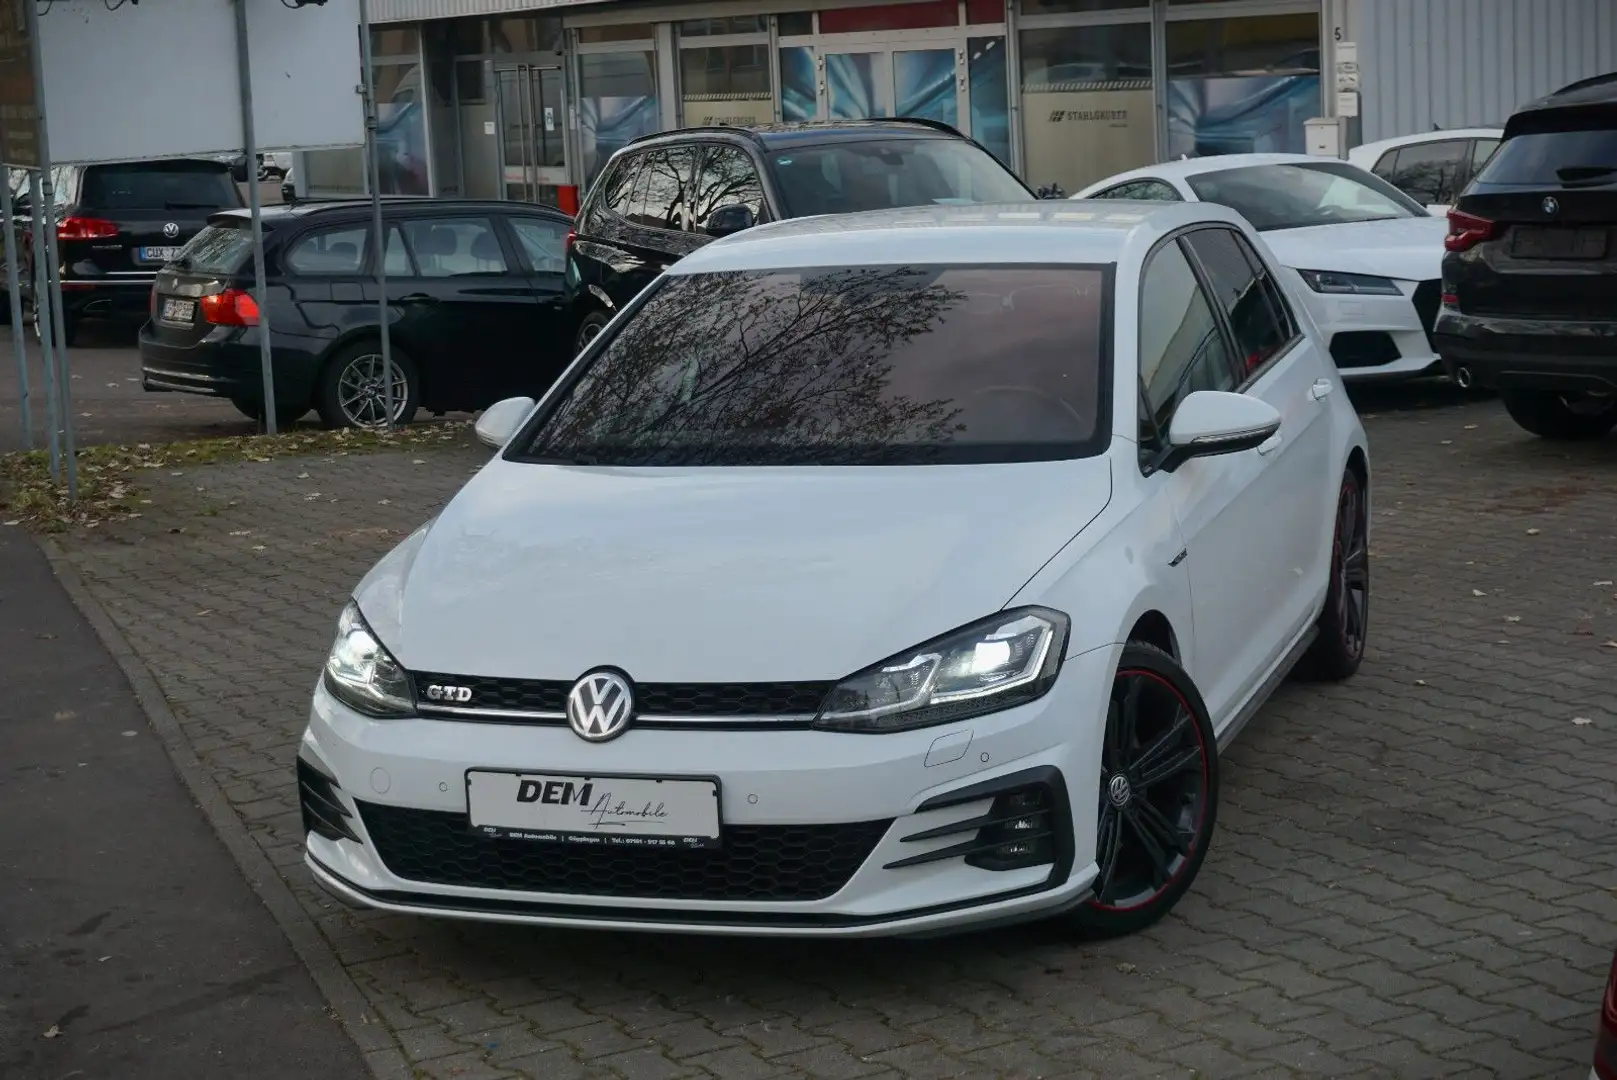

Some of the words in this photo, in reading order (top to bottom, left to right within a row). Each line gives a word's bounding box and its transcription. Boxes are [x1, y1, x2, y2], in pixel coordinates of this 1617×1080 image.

[1335, 26, 1342, 41] 5
[146, 247, 165, 258] CUX
[427, 684, 473, 702] GTD
[516, 779, 594, 806] DEM
[581, 792, 669, 829] Automobile
